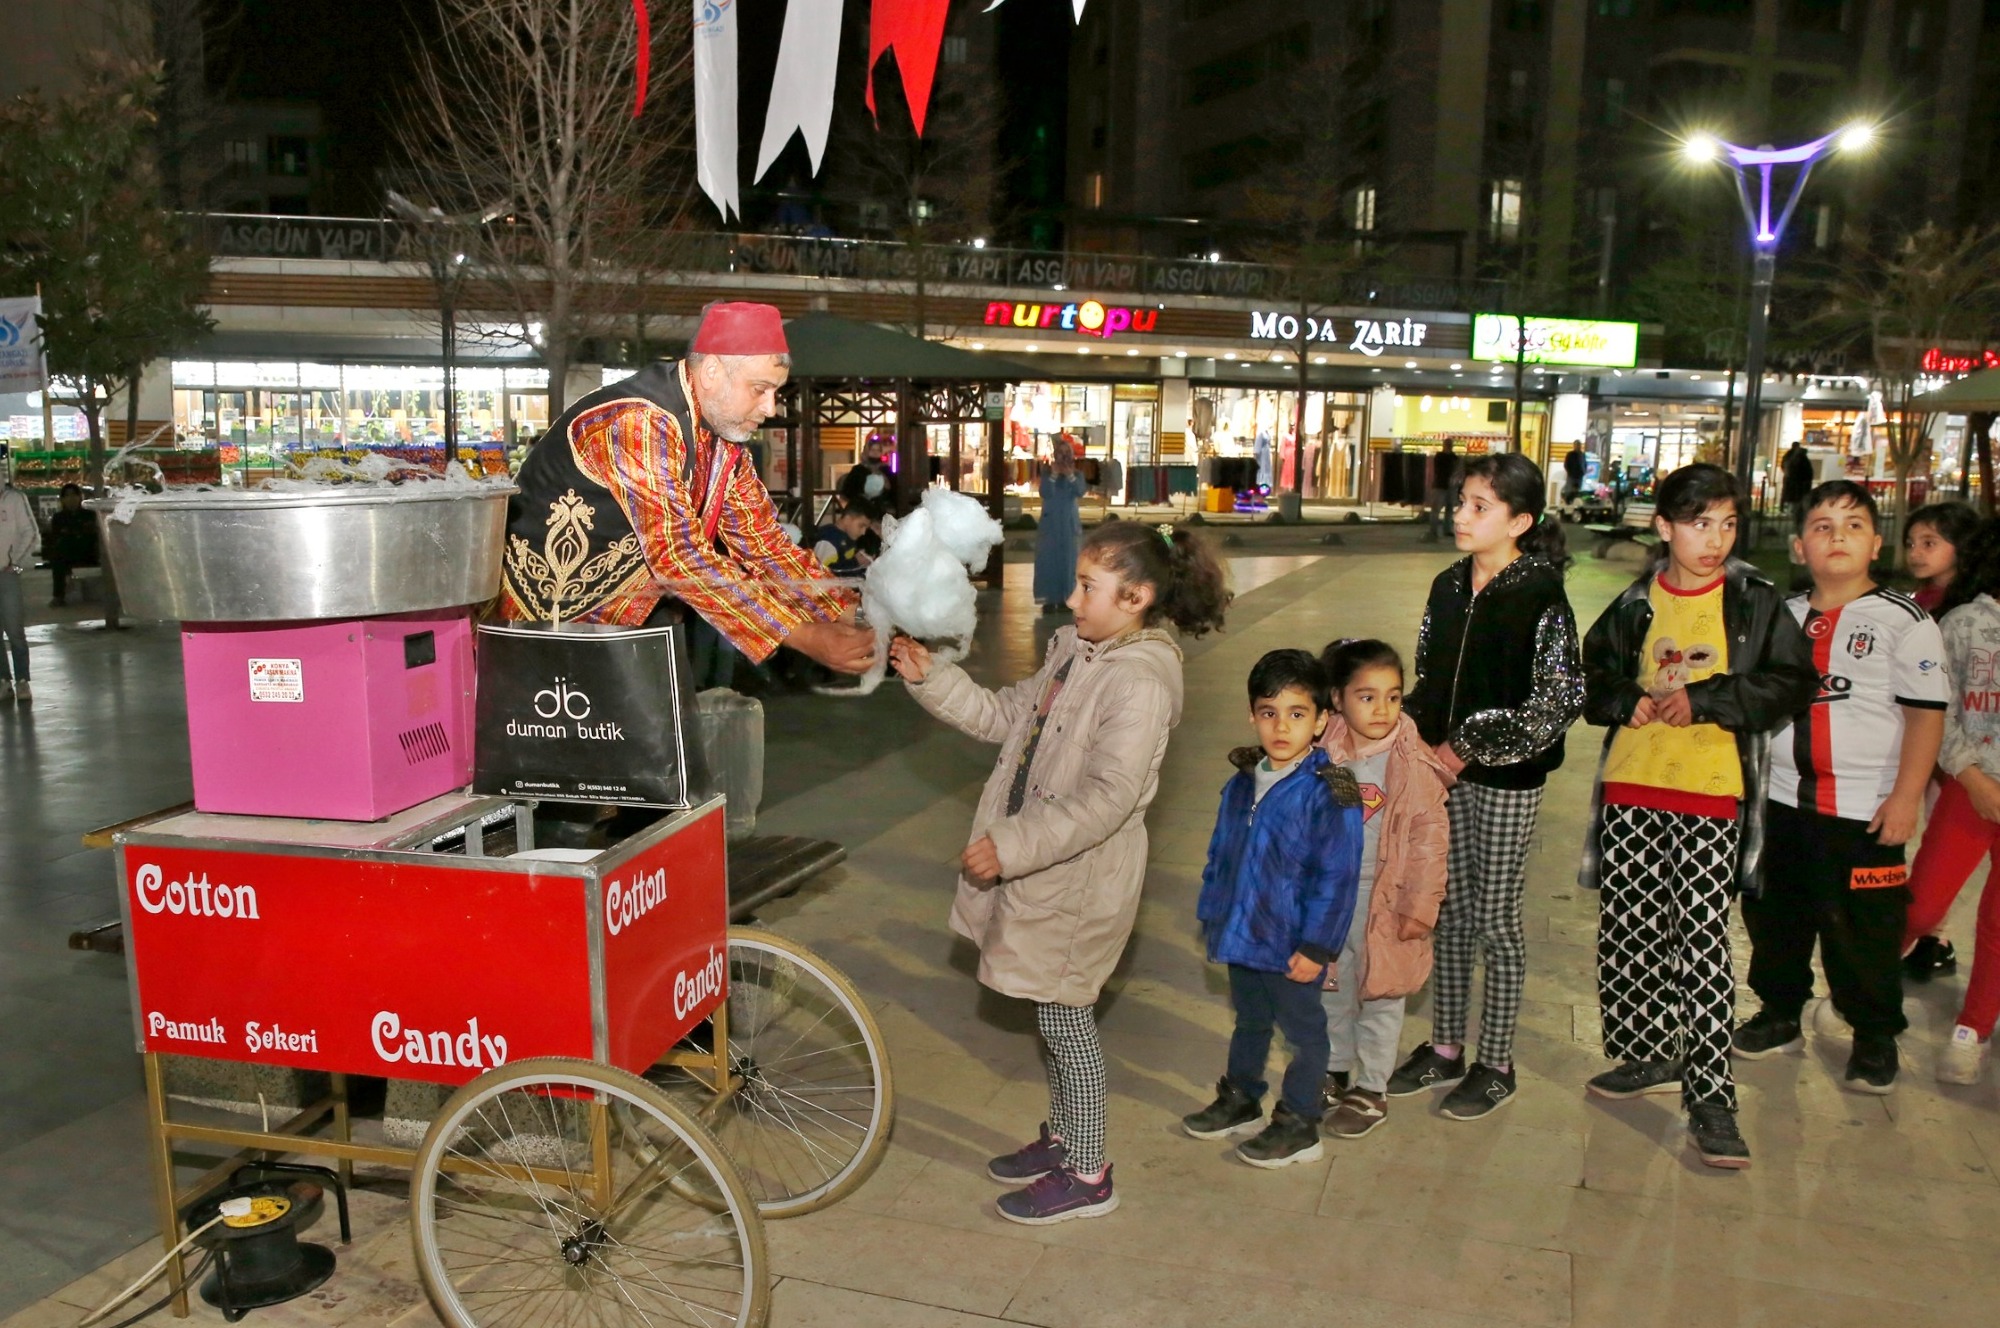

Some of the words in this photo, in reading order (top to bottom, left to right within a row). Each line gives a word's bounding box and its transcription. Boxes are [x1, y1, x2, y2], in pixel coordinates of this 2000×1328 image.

[219, 221, 308, 251] ASGÜN
[316, 226, 372, 254] YAPI
[957, 255, 1001, 280] YAPI
[1092, 261, 1138, 288] YAPI
[983, 300, 1159, 339] nurtopu
[1349, 317, 1428, 357] ZARİF
[506, 718, 567, 739] duman
[577, 721, 625, 742] butik
[135, 863, 260, 920] Cotton
[606, 867, 668, 936] Cotton
[673, 944, 724, 1021] Candy
[148, 1011, 227, 1044] Pamuk
[245, 1021, 319, 1053] Şekeri
[371, 1010, 508, 1074] Candy
